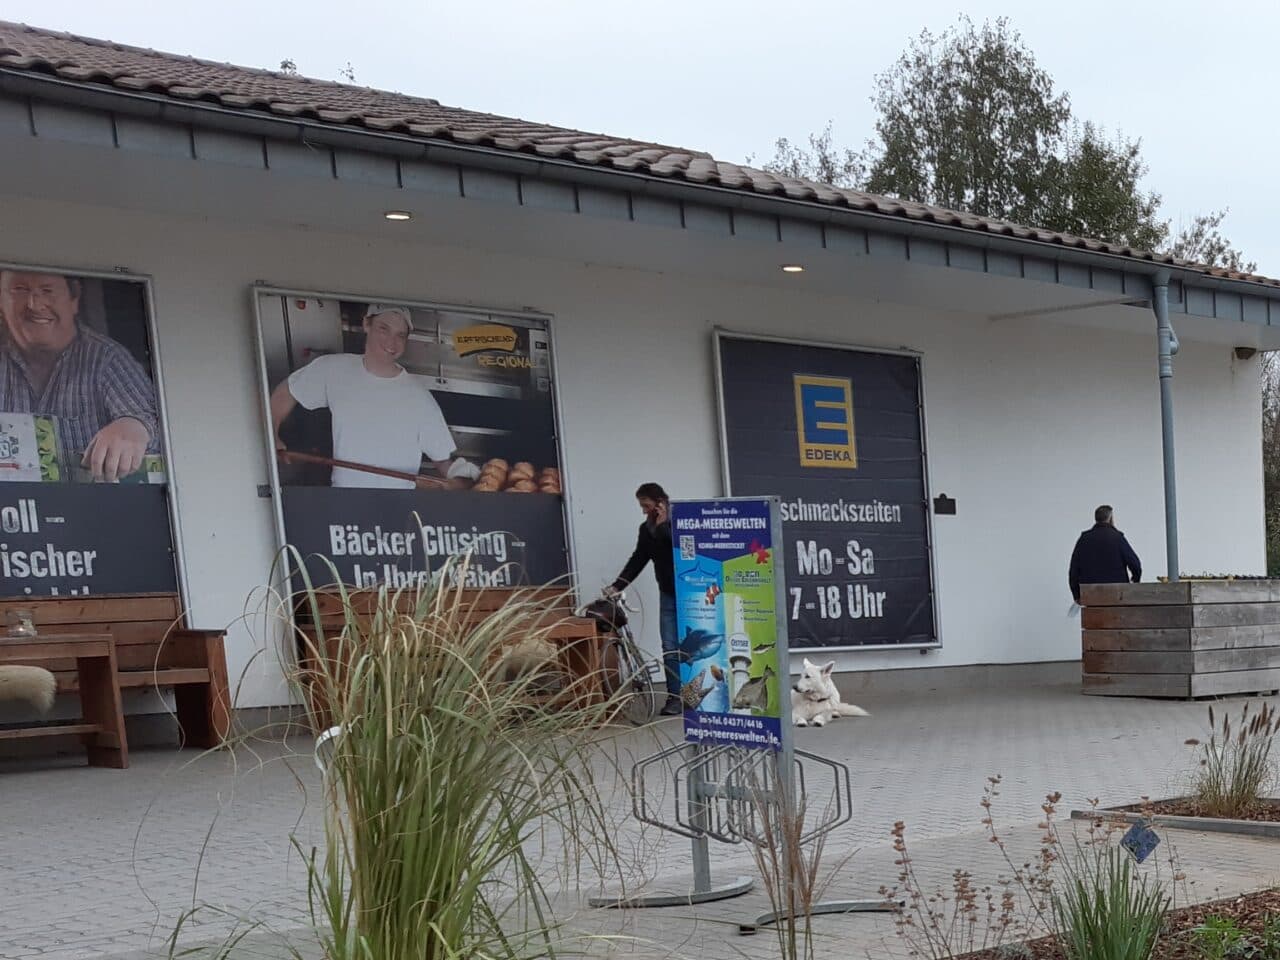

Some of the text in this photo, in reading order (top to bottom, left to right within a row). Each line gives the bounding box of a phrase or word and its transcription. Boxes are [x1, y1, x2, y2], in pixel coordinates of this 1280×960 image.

[805, 449, 852, 461] EDEKA
[0, 498, 39, 533] oll
[676, 517, 767, 530] MEGA-MEERESWELTEN
[780, 498, 901, 522] schmackszeiten
[0, 543, 97, 578] ischer
[328, 525, 416, 556] Bäcker
[421, 525, 507, 562] Glüsing
[847, 584, 887, 619] Uhr
